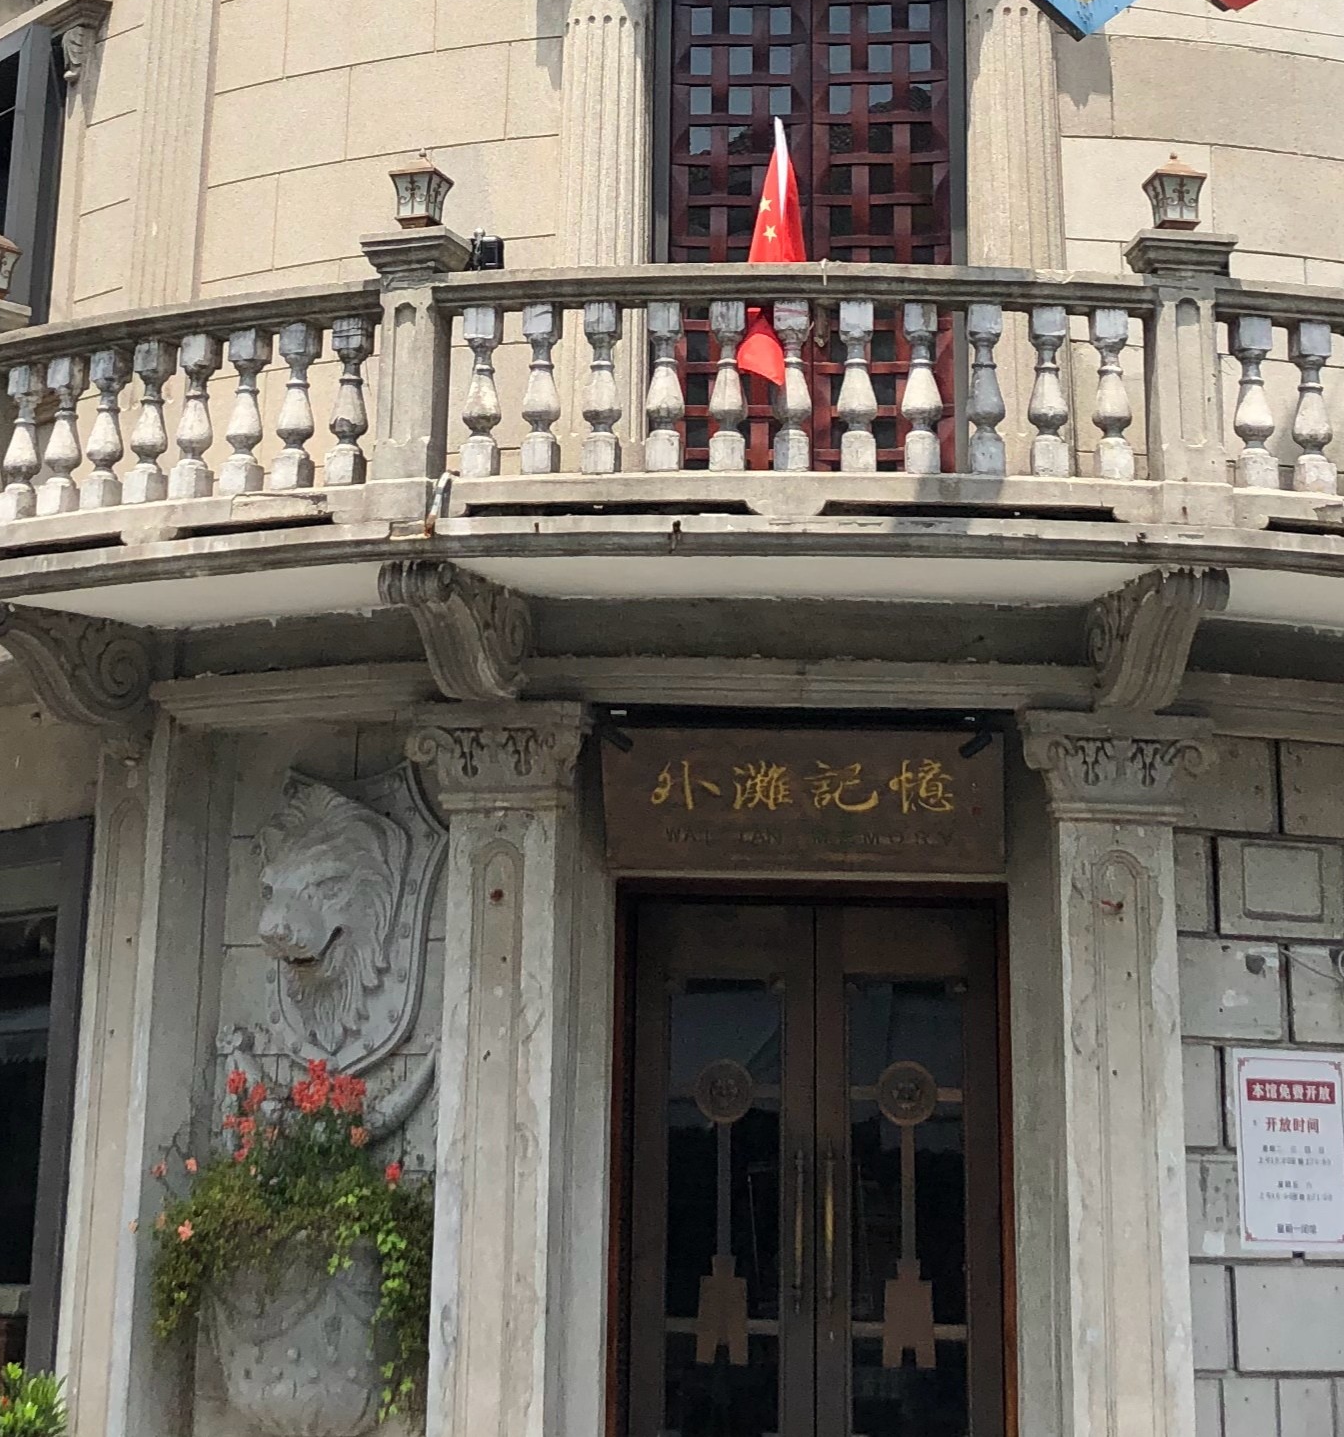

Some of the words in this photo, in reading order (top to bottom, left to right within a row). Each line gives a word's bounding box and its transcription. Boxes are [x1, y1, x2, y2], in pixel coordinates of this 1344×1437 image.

[1252, 1082, 1332, 1103] 本馆免费开放
[1264, 1116, 1320, 1135] 开放时间
